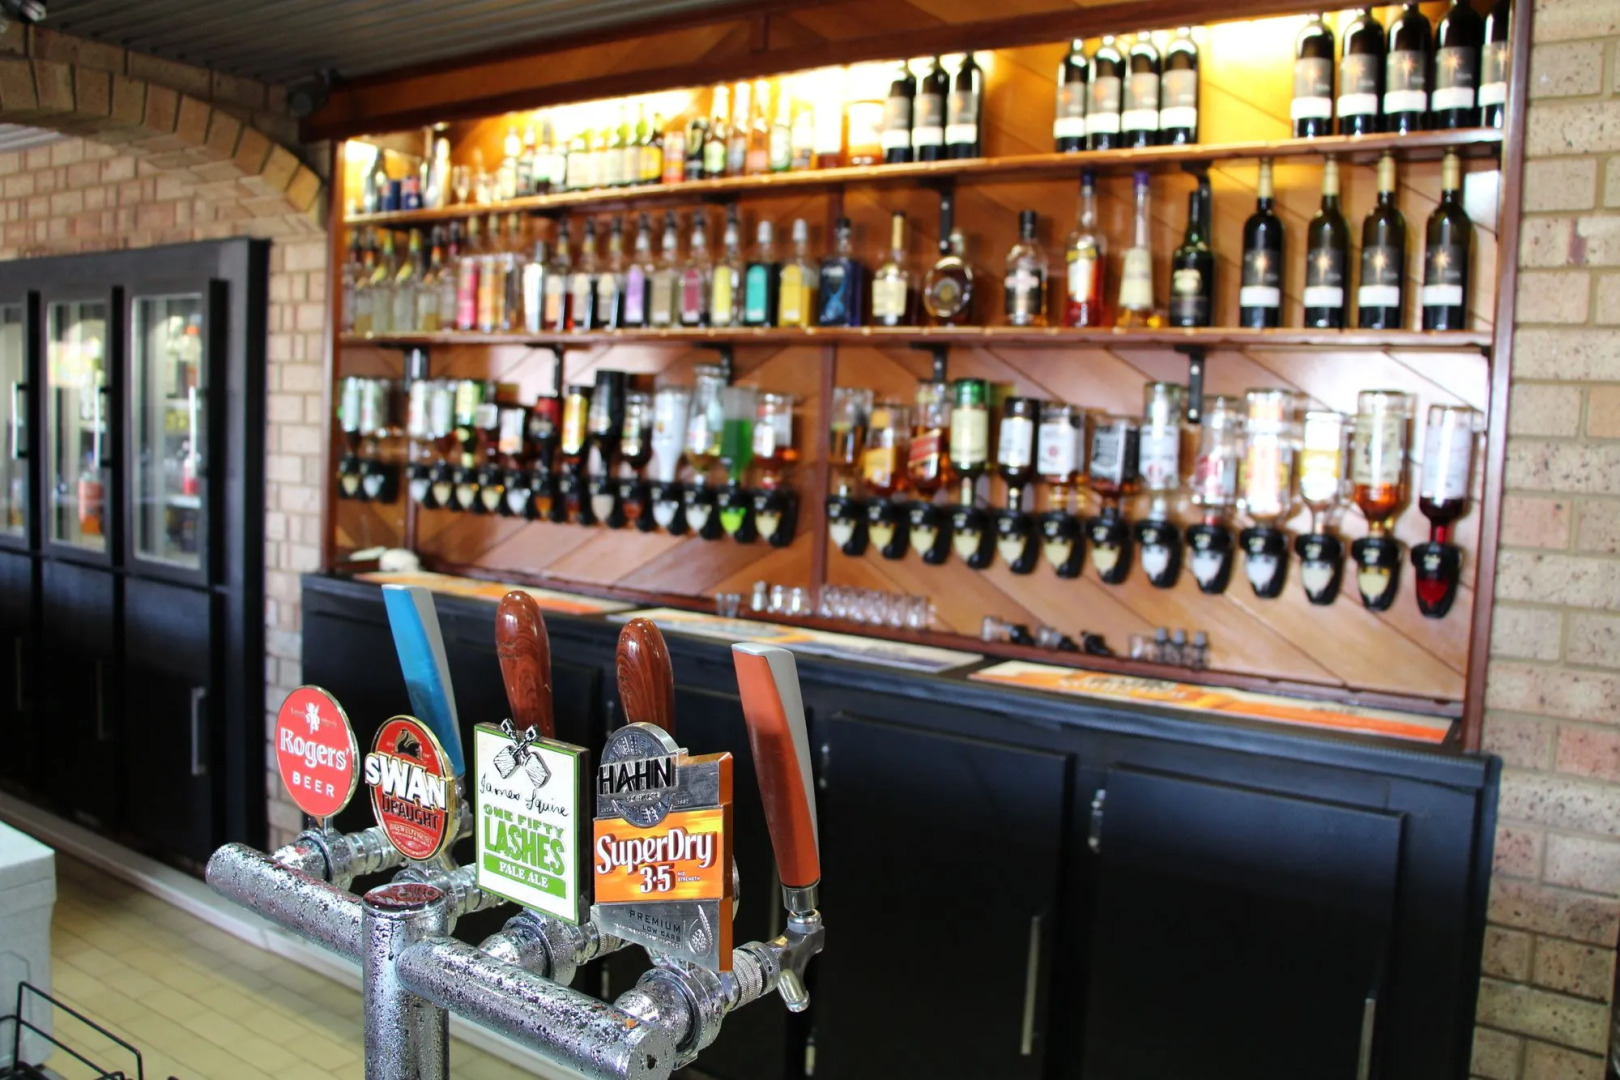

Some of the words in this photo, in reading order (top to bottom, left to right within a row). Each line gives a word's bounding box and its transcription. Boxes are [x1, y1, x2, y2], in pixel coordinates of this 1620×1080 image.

[292, 771, 334, 798] BEER
[365, 753, 447, 811] SWAN
[599, 757, 672, 795] HAHN
[382, 794, 438, 830] DRAUGHT
[479, 773, 521, 801] James
[525, 788, 569, 818] Squire
[483, 803, 513, 822] ONE
[518, 814, 565, 839] FIFTY
[484, 815, 565, 876] LASHES
[596, 827, 716, 876] SuperDry
[499, 862, 525, 880] PALE
[528, 870, 549, 888] ALE
[629, 909, 682, 934] PREMIUM
[642, 924, 658, 936] LOW
[660, 930, 682, 942] CARB
